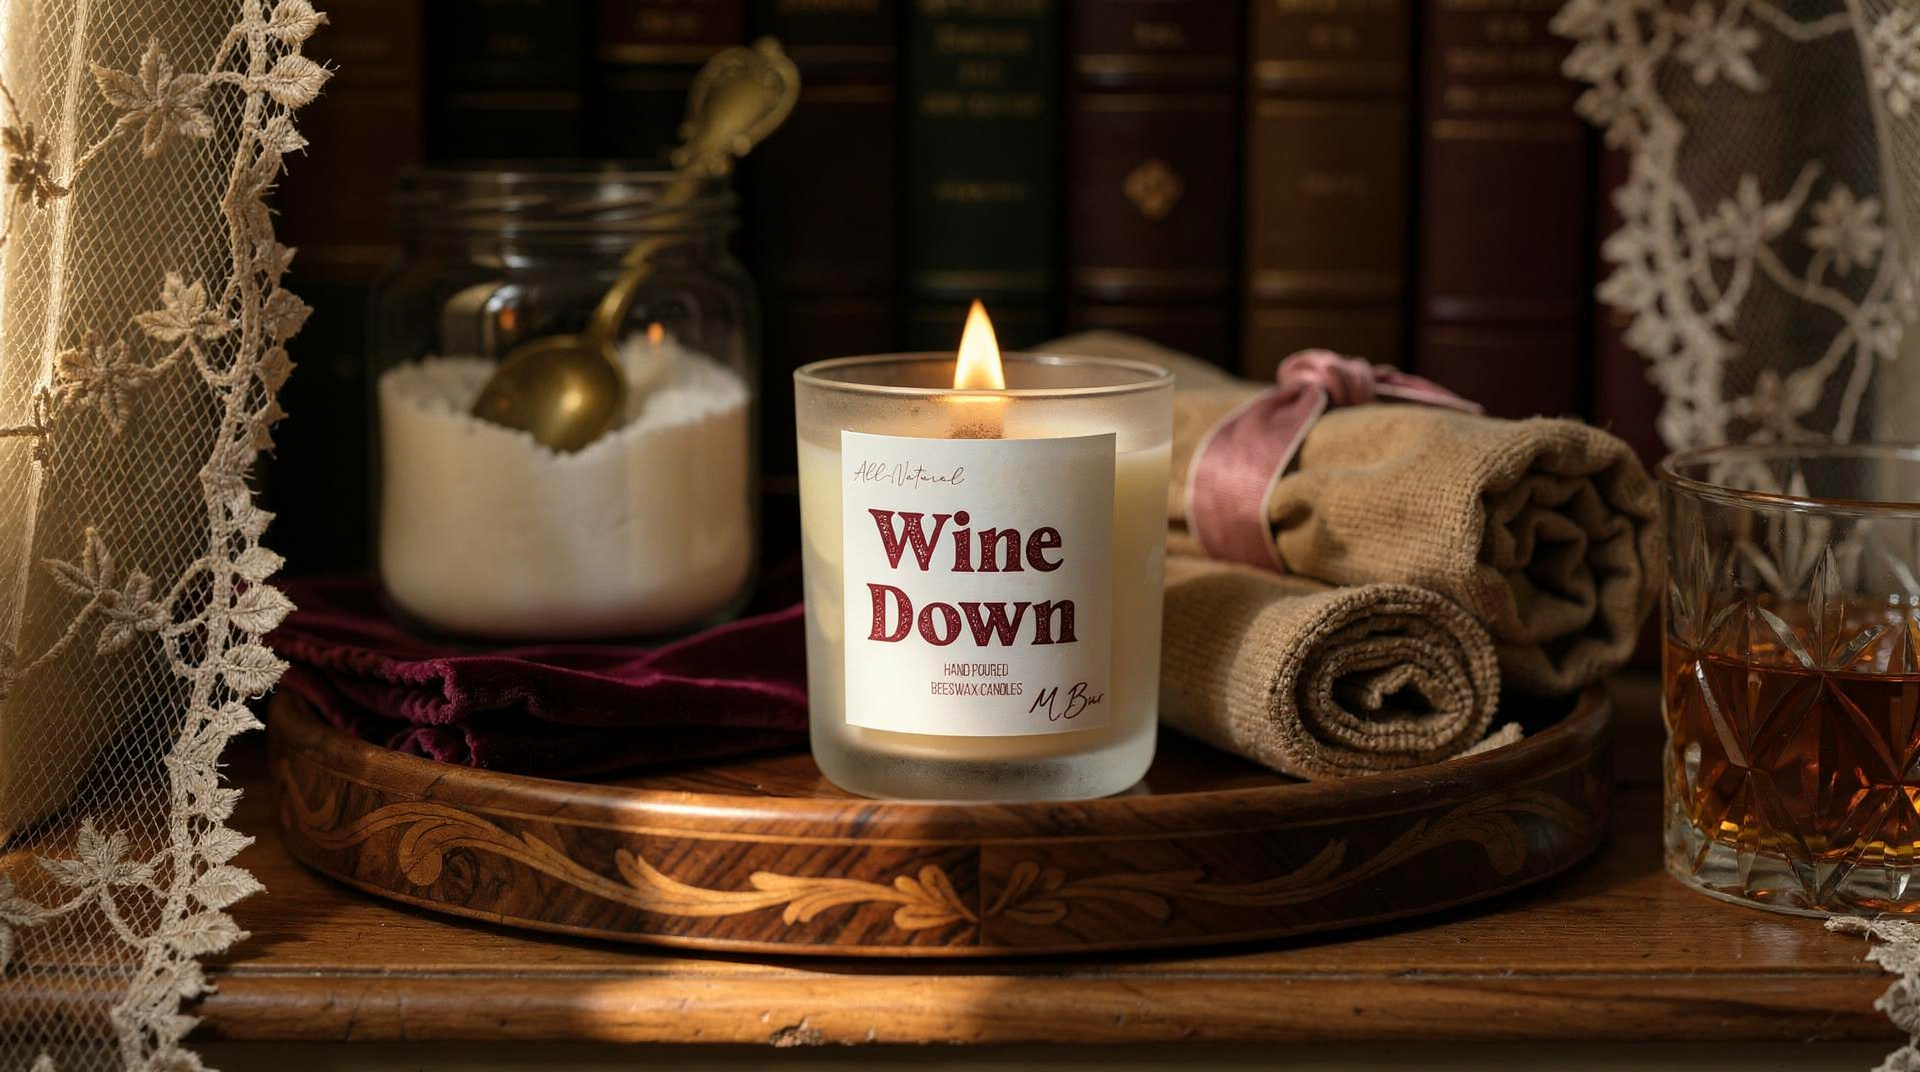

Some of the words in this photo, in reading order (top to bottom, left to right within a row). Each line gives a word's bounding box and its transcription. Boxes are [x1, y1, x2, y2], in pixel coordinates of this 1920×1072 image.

[868, 508, 1064, 572] Wine
[866, 583, 1079, 646] Down
[931, 681, 979, 696] BEESWAX
[980, 682, 1023, 696] CANDLES
[944, 663, 970, 677] HAND
[972, 663, 1009, 677] POURED
